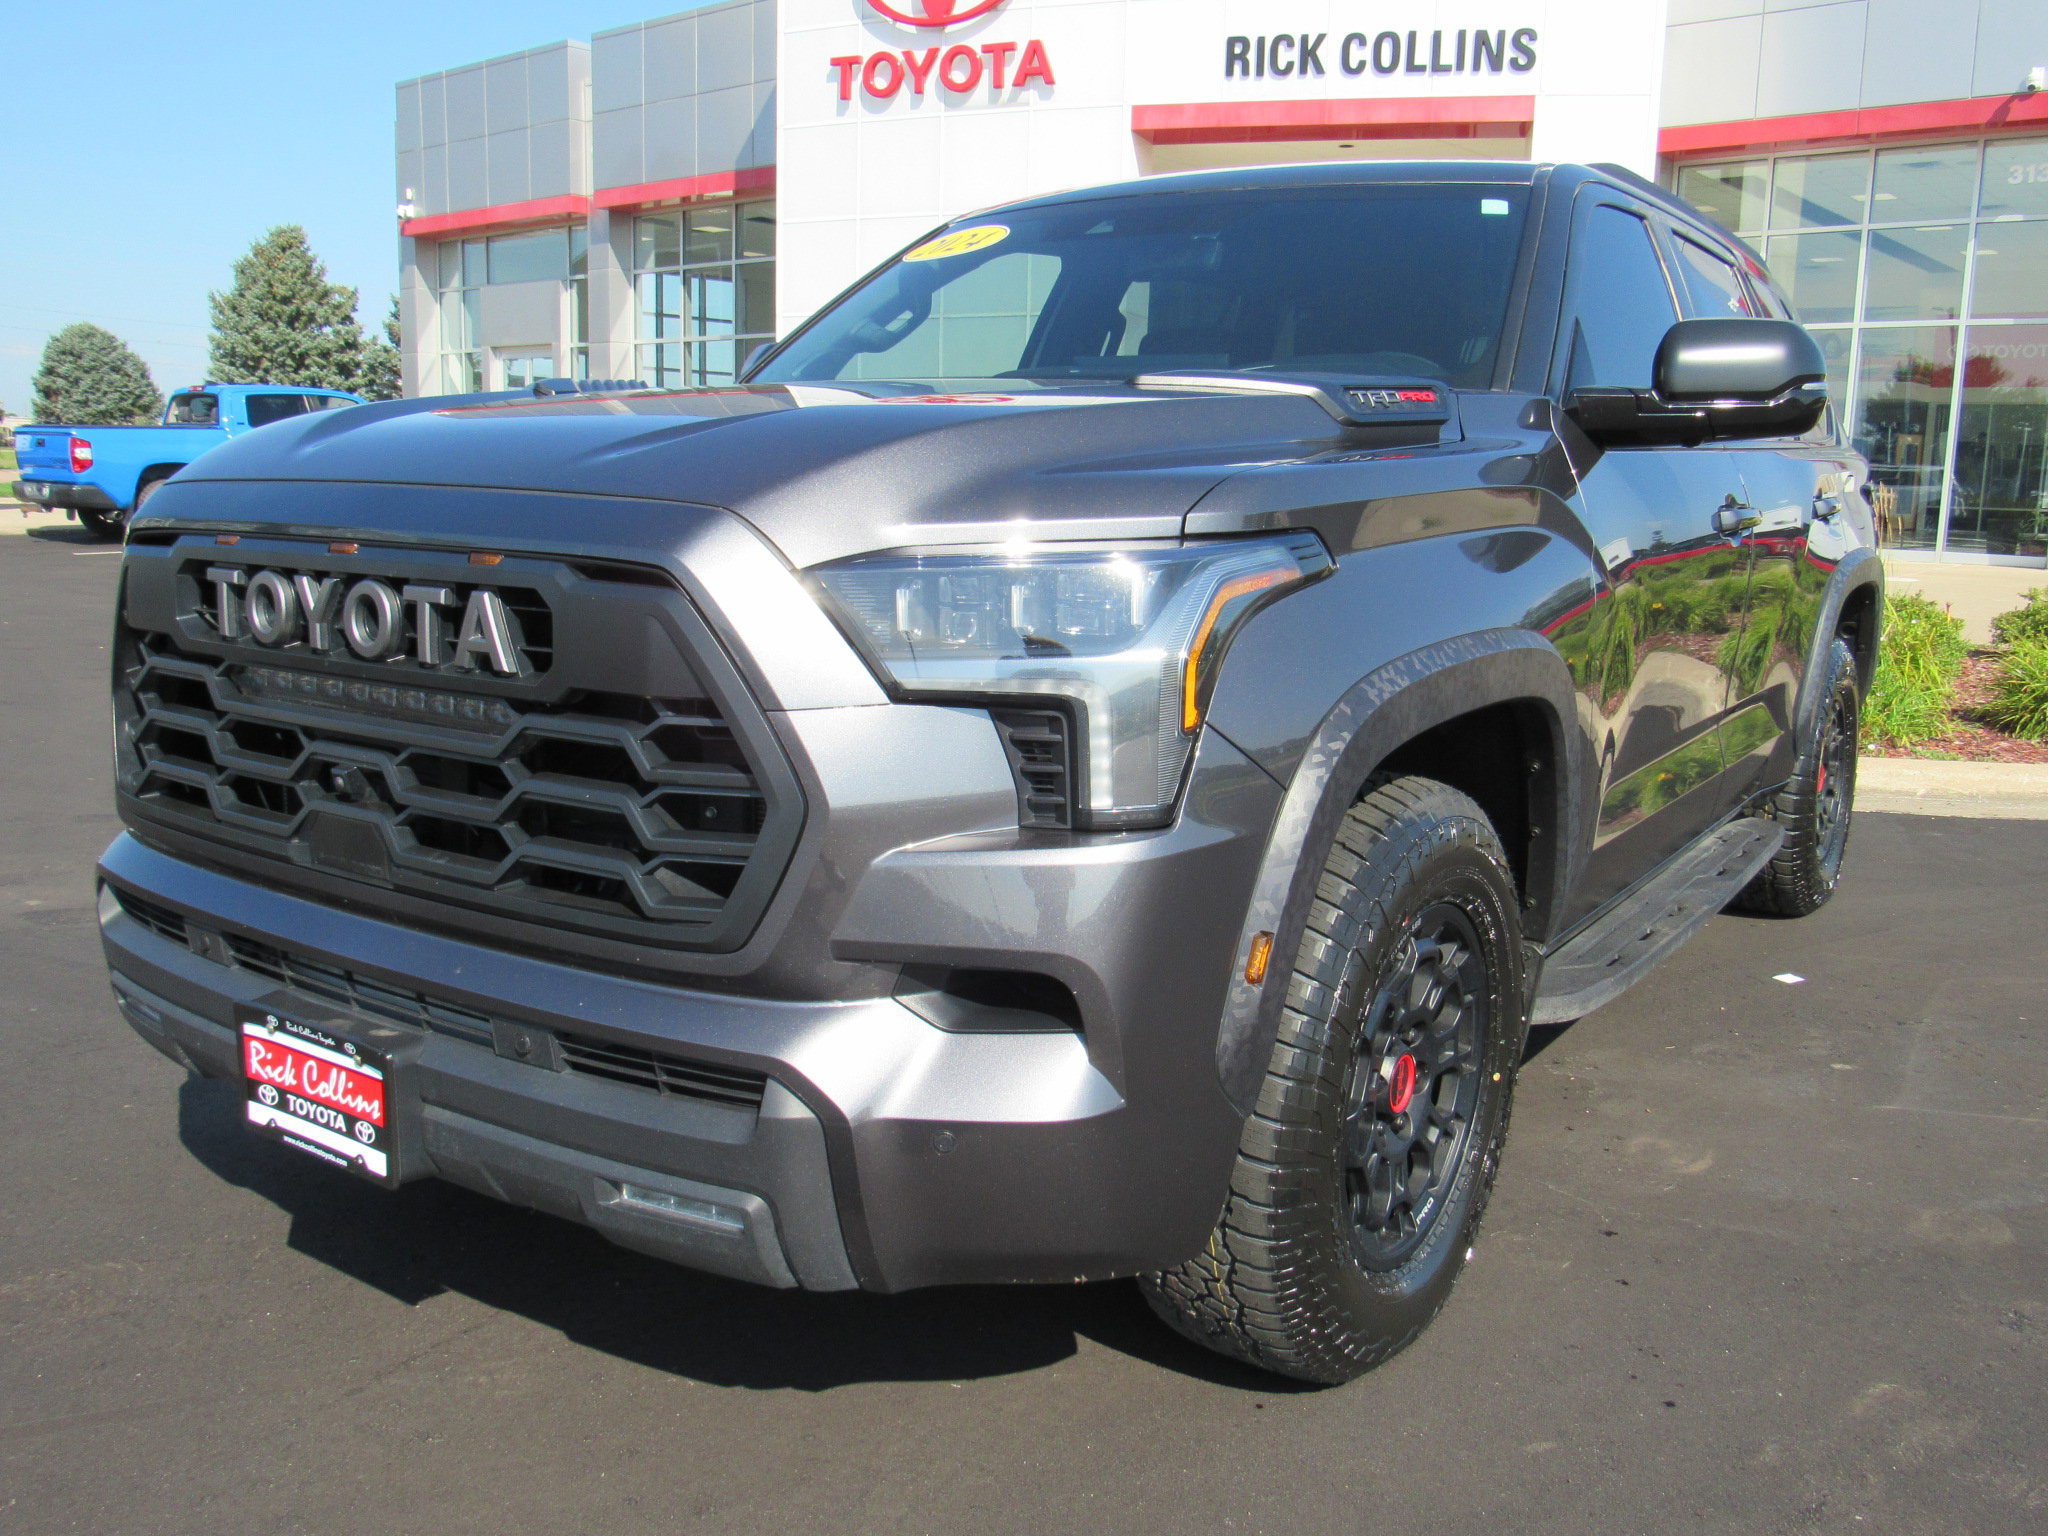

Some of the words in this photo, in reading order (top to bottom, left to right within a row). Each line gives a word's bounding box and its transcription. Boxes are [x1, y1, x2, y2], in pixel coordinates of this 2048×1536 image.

[830, 39, 1055, 101] TOYOTA
[1225, 33, 1327, 77] RICK
[1341, 28, 1537, 75] COLLINS
[1349, 390, 1400, 408] TRD
[206, 566, 522, 676] TOYOTA
[249, 1040, 297, 1087] Rick
[303, 1060, 381, 1120] Collins
[286, 1094, 347, 1132] TOYOTA
[1416, 1196, 1434, 1225] PRO
